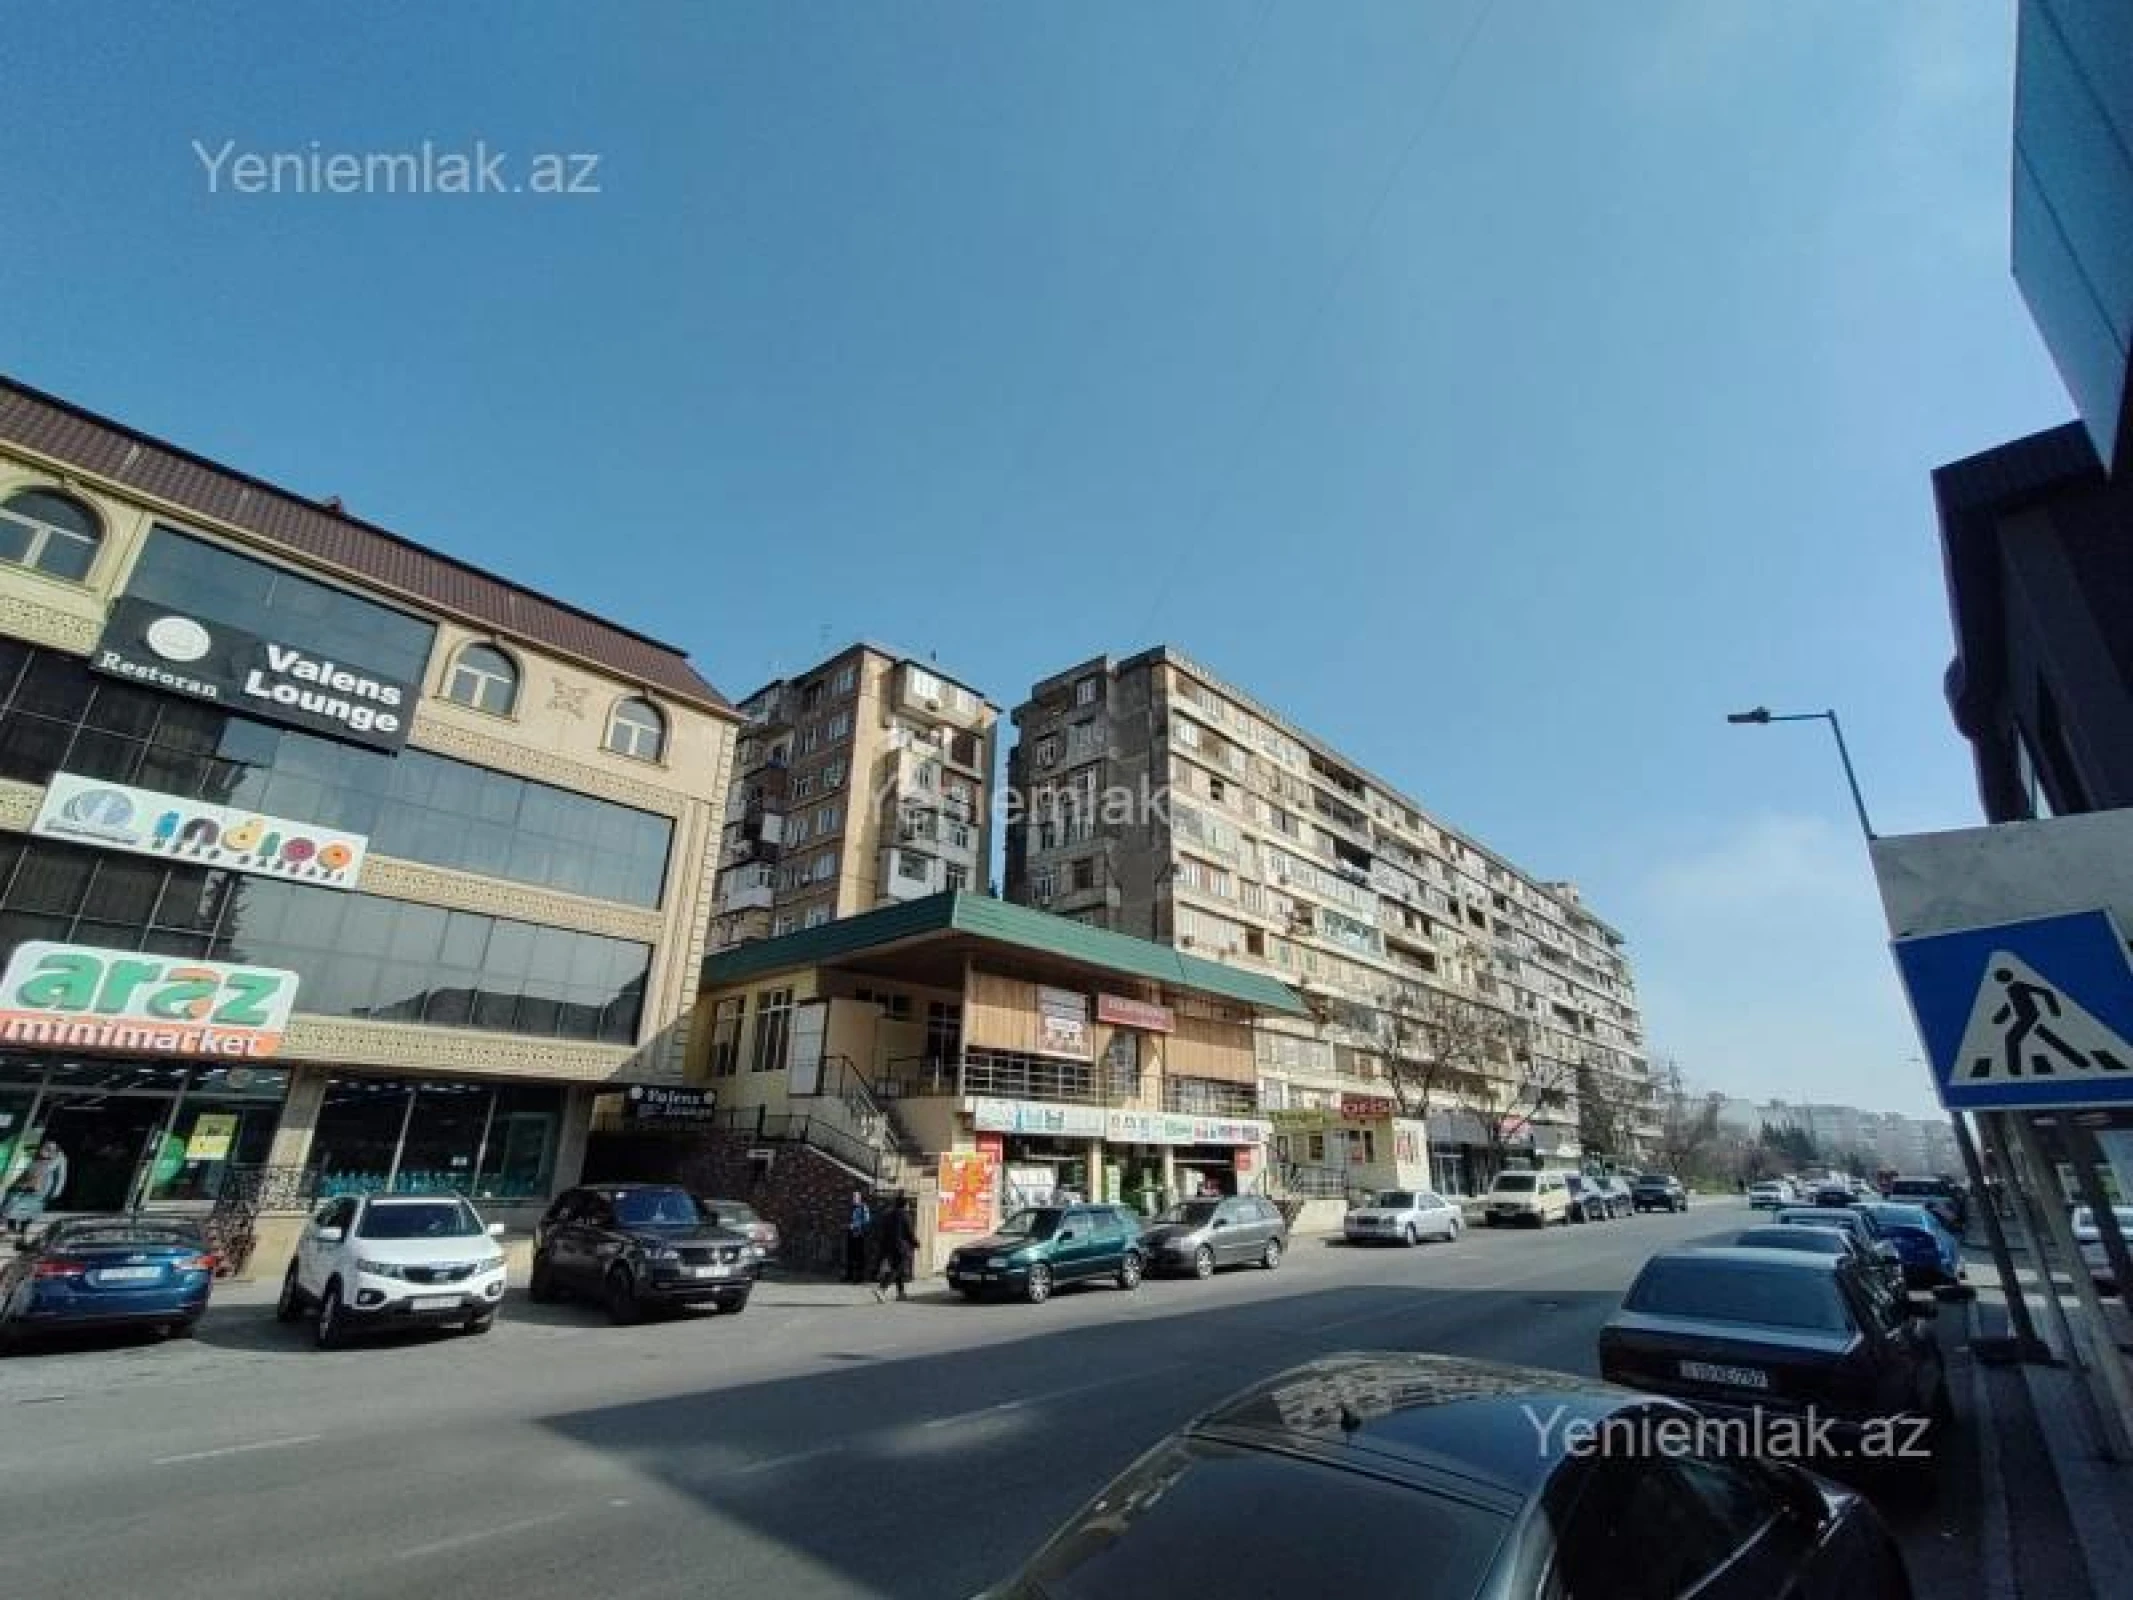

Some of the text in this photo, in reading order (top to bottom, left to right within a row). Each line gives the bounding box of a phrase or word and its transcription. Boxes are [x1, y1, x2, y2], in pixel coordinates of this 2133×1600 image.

[100, 649, 218, 699] Restoran
[244, 668, 399, 733] Lounge
[266, 643, 401, 705] Valens
[15, 953, 284, 1026] araz
[2, 1017, 264, 1056] minimarket
